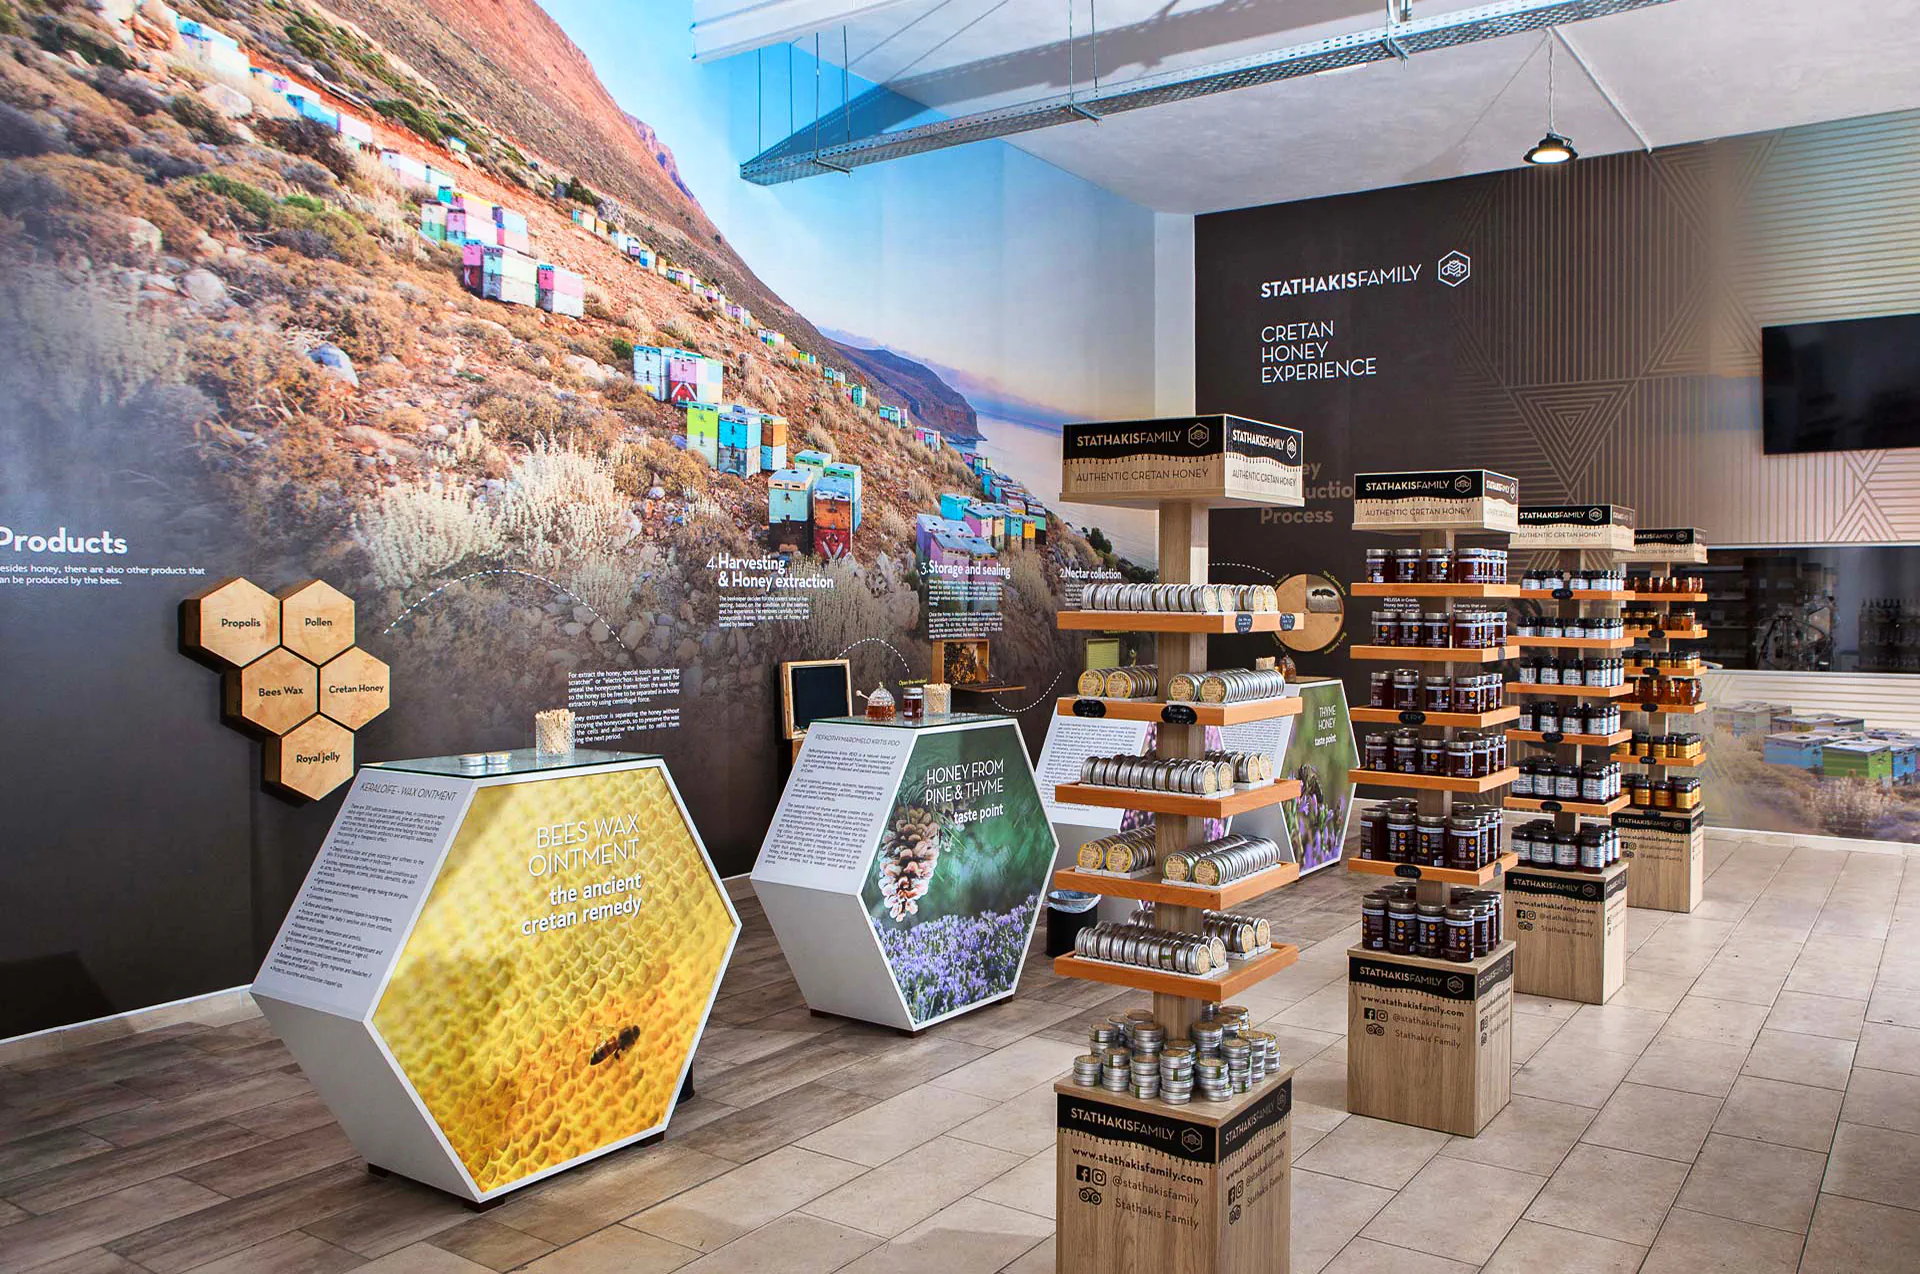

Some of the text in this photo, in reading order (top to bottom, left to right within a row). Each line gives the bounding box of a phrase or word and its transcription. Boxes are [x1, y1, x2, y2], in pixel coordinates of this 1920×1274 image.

[1260, 263, 1422, 298] STATHAKISFAMILY
[1261, 320, 1334, 343] CRETAN
[1261, 341, 1329, 363] HONEY
[1261, 357, 1377, 384] EXPERIENCE
[1076, 430, 1182, 447] STATHAKISFAMILY
[1232, 429, 1285, 451] STATHAKISFAMILY
[1076, 468, 1209, 482] AUTHENTIC CRETAN HONEY
[1232, 469, 1297, 487] AUTHENTIC CRETAN HONEY
[1365, 480, 1450, 492] STATHAKISFAMILY
[1260, 507, 1334, 525] Process
[1365, 507, 1472, 517] AUTHENTIC CRETAN HONEY
[1519, 511, 1586, 520] STATHAKISFAMILY
[0, 526, 128, 554] Products
[30, 564, 62, 575] honey,
[64, 564, 88, 574] there
[105, 565, 124, 574] also
[126, 566, 150, 574] other
[151, 566, 187, 576] products
[188, 567, 206, 575] that
[964, 562, 981, 576] and
[982, 562, 1011, 580] sealing
[1090, 567, 1122, 580] collection
[12, 576, 24, 584] be
[26, 576, 69, 586] produced
[70, 576, 82, 586] by
[83, 576, 98, 584] the
[100, 576, 122, 585] bees.
[718, 571, 834, 592] & Honey extraction
[221, 618, 261, 628] Propolis
[304, 618, 333, 626] Pollen
[258, 686, 304, 697] Bees Wax
[328, 684, 384, 694] Cretan Honey
[592, 700, 598, 708] by
[1319, 704, 1336, 718] THYME
[1318, 718, 1336, 730] HONEY
[1326, 733, 1337, 747] point
[296, 752, 340, 765] Royal jelly
[926, 758, 1004, 785] HONEY FROM
[401, 786, 418, 797] WAX
[418, 788, 458, 802] OINTMENT
[926, 777, 1004, 806] PINE & THYME
[954, 804, 1004, 824] taste point
[536, 812, 640, 849] BEES WAX
[528, 838, 640, 877] OINTMENT
[549, 873, 642, 906] the ancient
[1513, 878, 1580, 892] STATHAKISFAMILY
[521, 894, 642, 936] cretan remedy
[1514, 900, 1597, 915] www.stathakisfamily.com
[1540, 925, 1594, 938] Stathakis Family
[1359, 966, 1443, 987] STATHAKISFAMILY
[1360, 994, 1465, 1018] www.stathakisfamily.com
[1392, 1012, 1462, 1033] @stathakisfamily
[1394, 1029, 1462, 1050] Stathakis Family
[1070, 1107, 1175, 1140] STATHAKISFAMILY
[1225, 1102, 1274, 1145] STATHAKISFAMILY
[1072, 1147, 1204, 1186] www.stathakisfamily.com
[1112, 1175, 1200, 1208] @stathakisfamily
[1114, 1197, 1200, 1230] Stathakis Family
